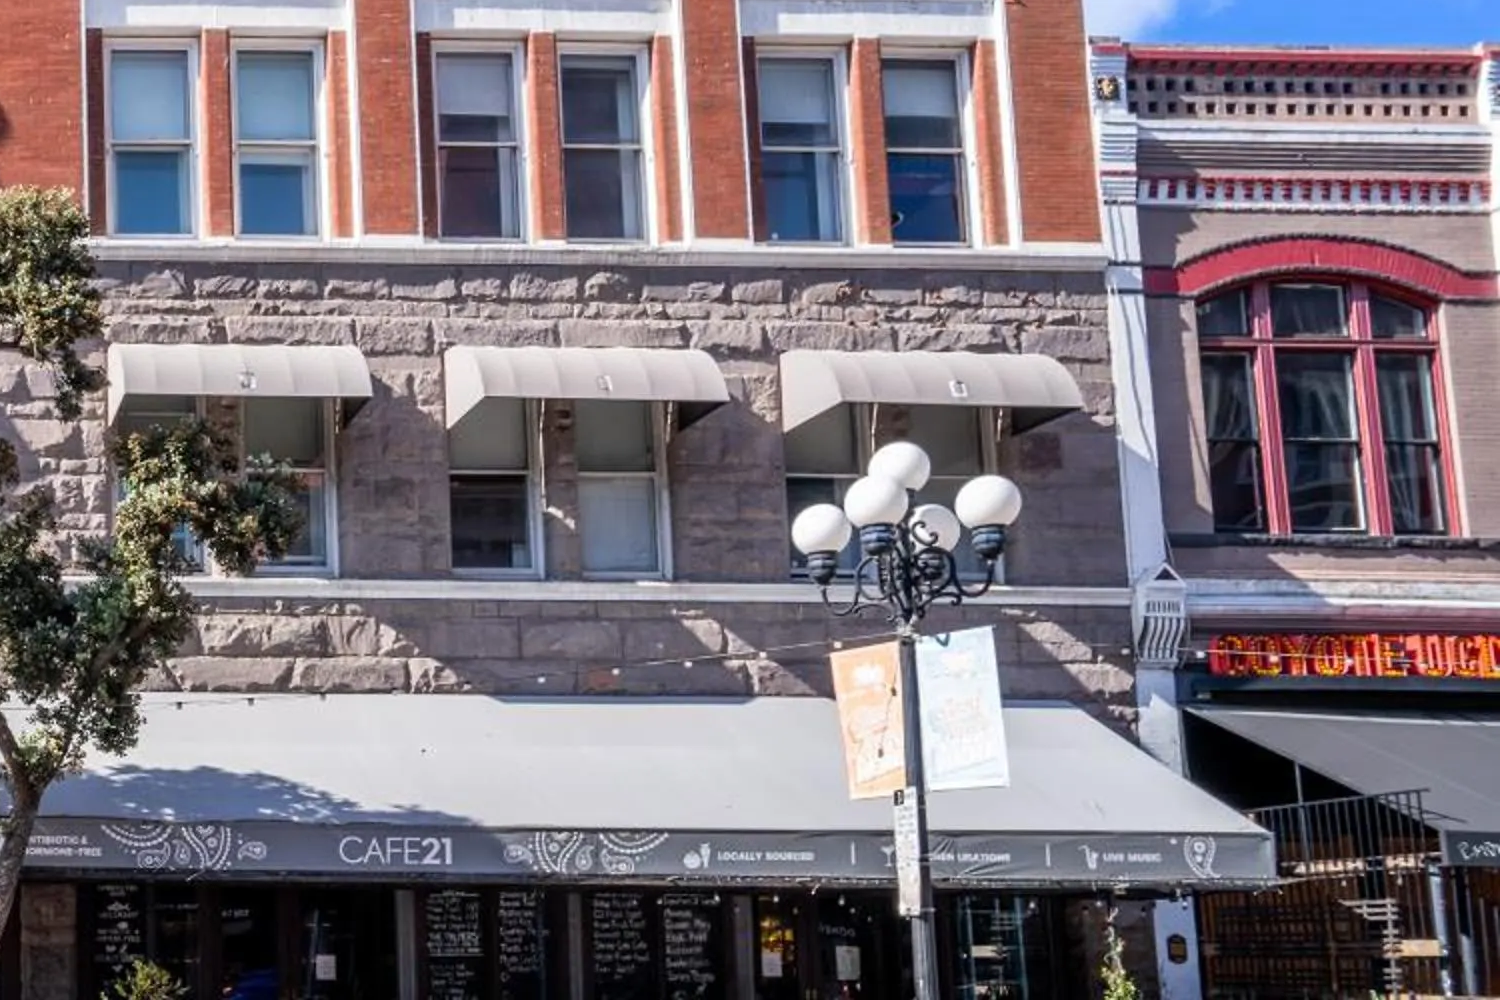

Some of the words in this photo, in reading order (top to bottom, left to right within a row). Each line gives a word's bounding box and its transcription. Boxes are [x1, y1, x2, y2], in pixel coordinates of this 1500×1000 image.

[1209, 633, 1405, 677] COYOTE
[1408, 634, 1500, 678] UGL
[28, 835, 79, 845] NTIBIOTIC
[717, 851, 762, 861] LOCALLY
[1127, 852, 1162, 862] MUSIC
